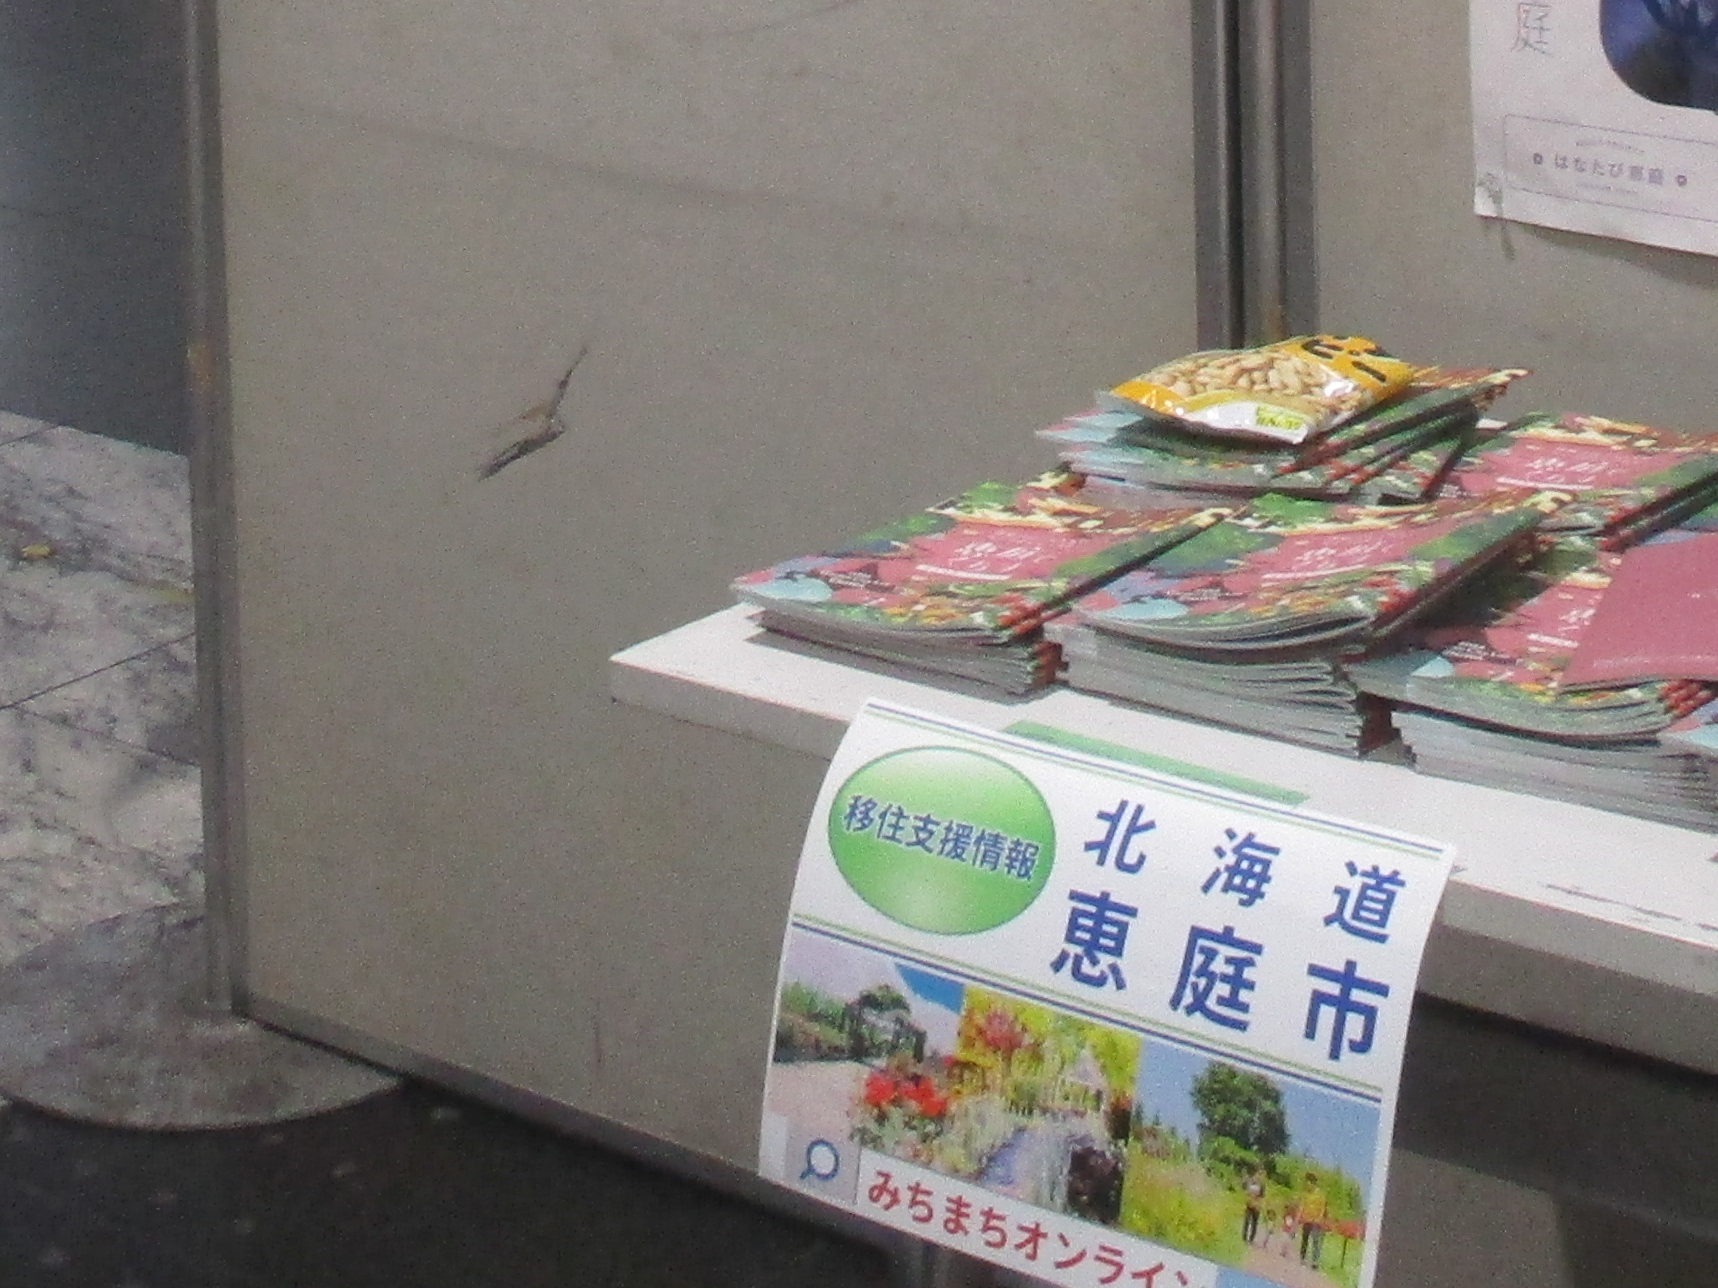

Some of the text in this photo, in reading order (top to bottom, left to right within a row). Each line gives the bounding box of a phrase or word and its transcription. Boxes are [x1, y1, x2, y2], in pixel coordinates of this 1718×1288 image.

[843, 793, 1041, 883] 移住支援情報
[1083, 797, 1408, 944] 北海道
[1049, 888, 1391, 1062] 恵庭市
